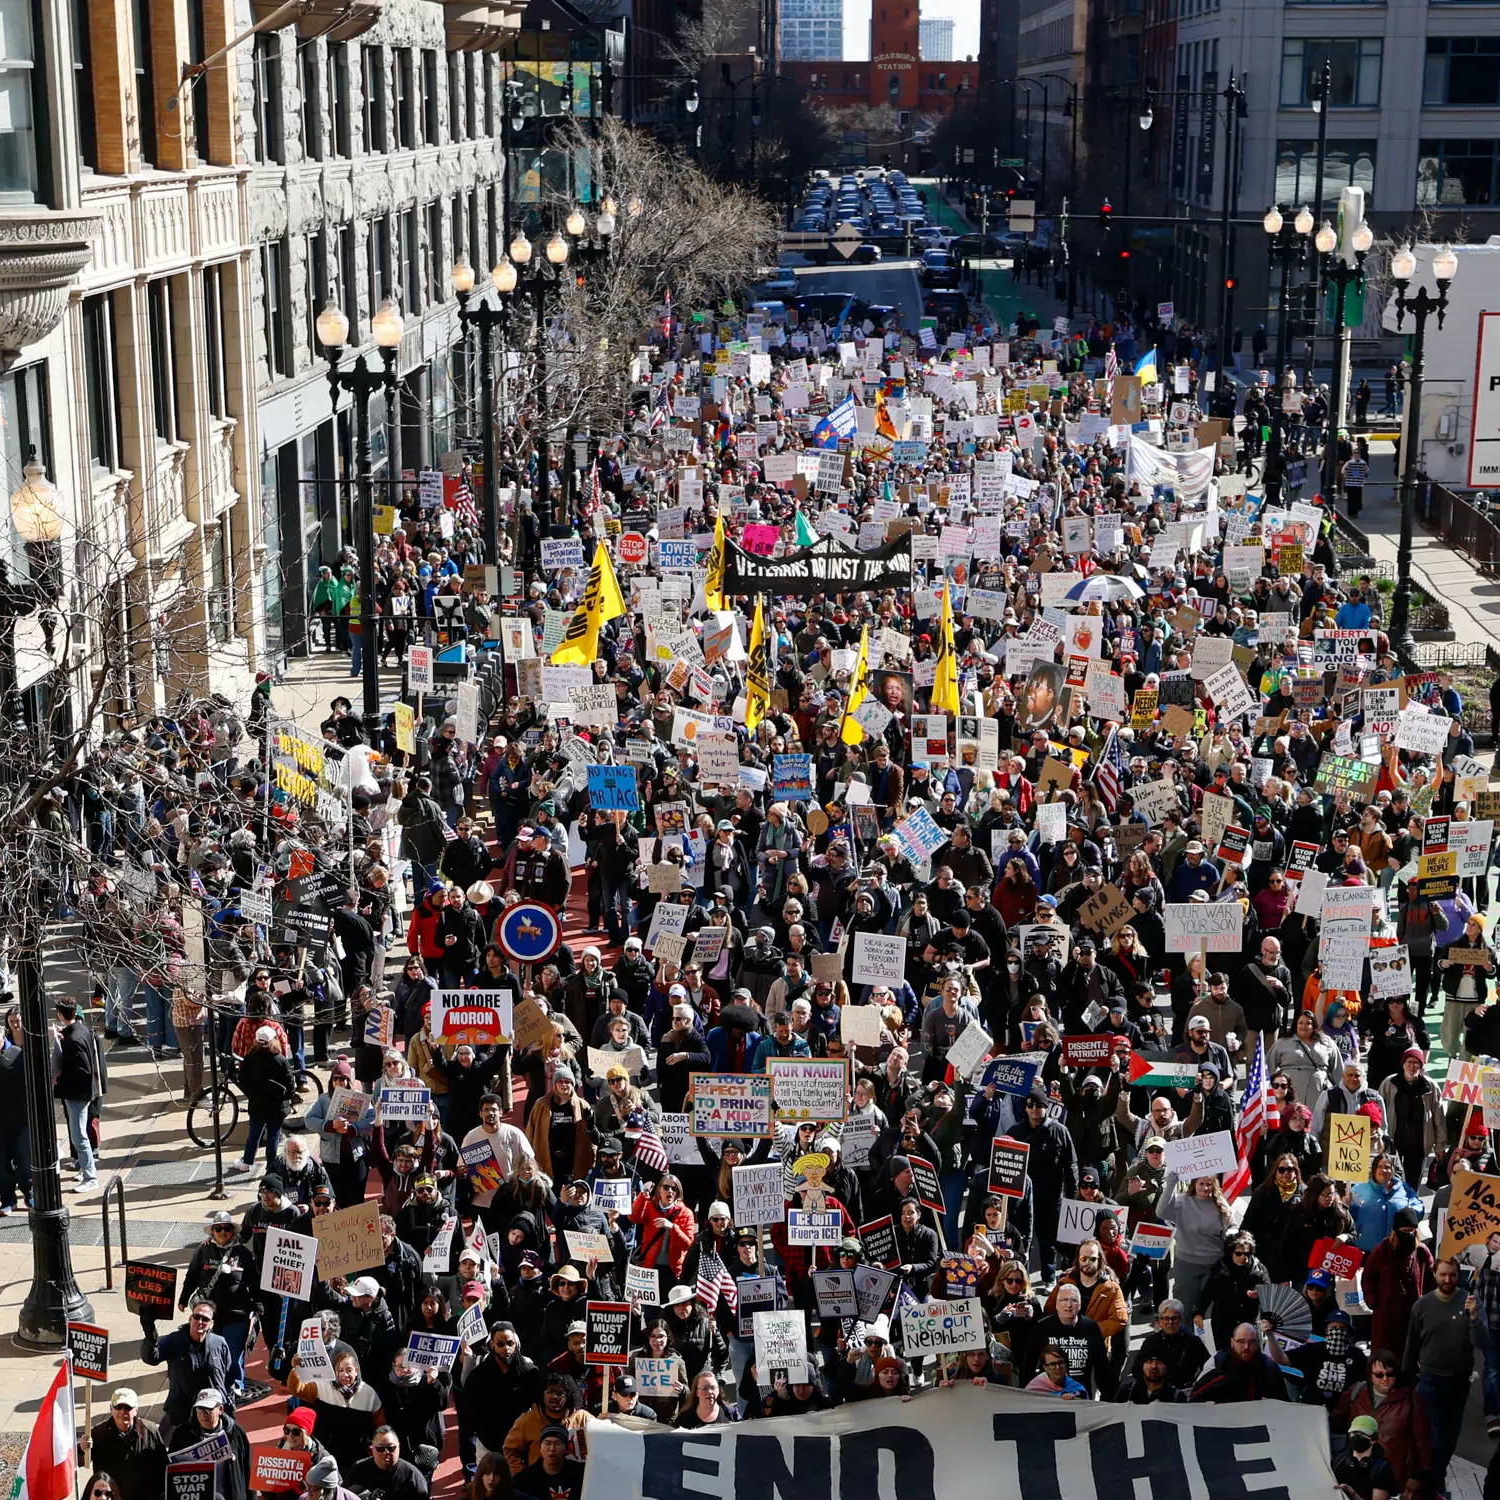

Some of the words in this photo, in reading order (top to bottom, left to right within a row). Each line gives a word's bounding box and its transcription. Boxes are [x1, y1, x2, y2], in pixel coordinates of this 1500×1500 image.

[874, 53, 916, 62] DEARBORN
[622, 540, 642, 548] STOP
[660, 542, 695, 554] LOWER
[621, 549, 644, 557] TRUMP
[660, 555, 695, 567] PRICES
[736, 554, 808, 578] VETERANS
[864, 560, 884, 581] THE
[887, 553, 910, 573] WAR
[412, 672, 428, 683] HOME
[1207, 678, 1220, 687] WE
[1220, 666, 1235, 679] THE
[1212, 676, 1238, 696] PEOPLE
[1232, 690, 1246, 702] THE
[1227, 700, 1247, 716] PEDO
[588, 766, 600, 778] NO
[604, 766, 634, 778] KINGS
[1352, 761, 1380, 775] MAKE
[1316, 772, 1353, 788] MYSELF
[1325, 785, 1367, 801] HISTORY
[442, 994, 460, 1008] NO
[463, 994, 500, 1008] MORE
[450, 1012, 493, 1025] MORON
[277, 1237, 303, 1250] JAIL
[279, 1248, 287, 1256] to
[289, 1250, 302, 1259] the
[273, 1256, 305, 1270] CHIEF!
[127, 1266, 175, 1282] ORANGE
[138, 1280, 162, 1293] LIES
[127, 1290, 170, 1304] MATTER
[950, 1300, 971, 1313] Not
[943, 1315, 972, 1329] our
[172, 1474, 209, 1484] STOP
[175, 1483, 205, 1493] WAR
[180, 1492, 200, 1500] ON
